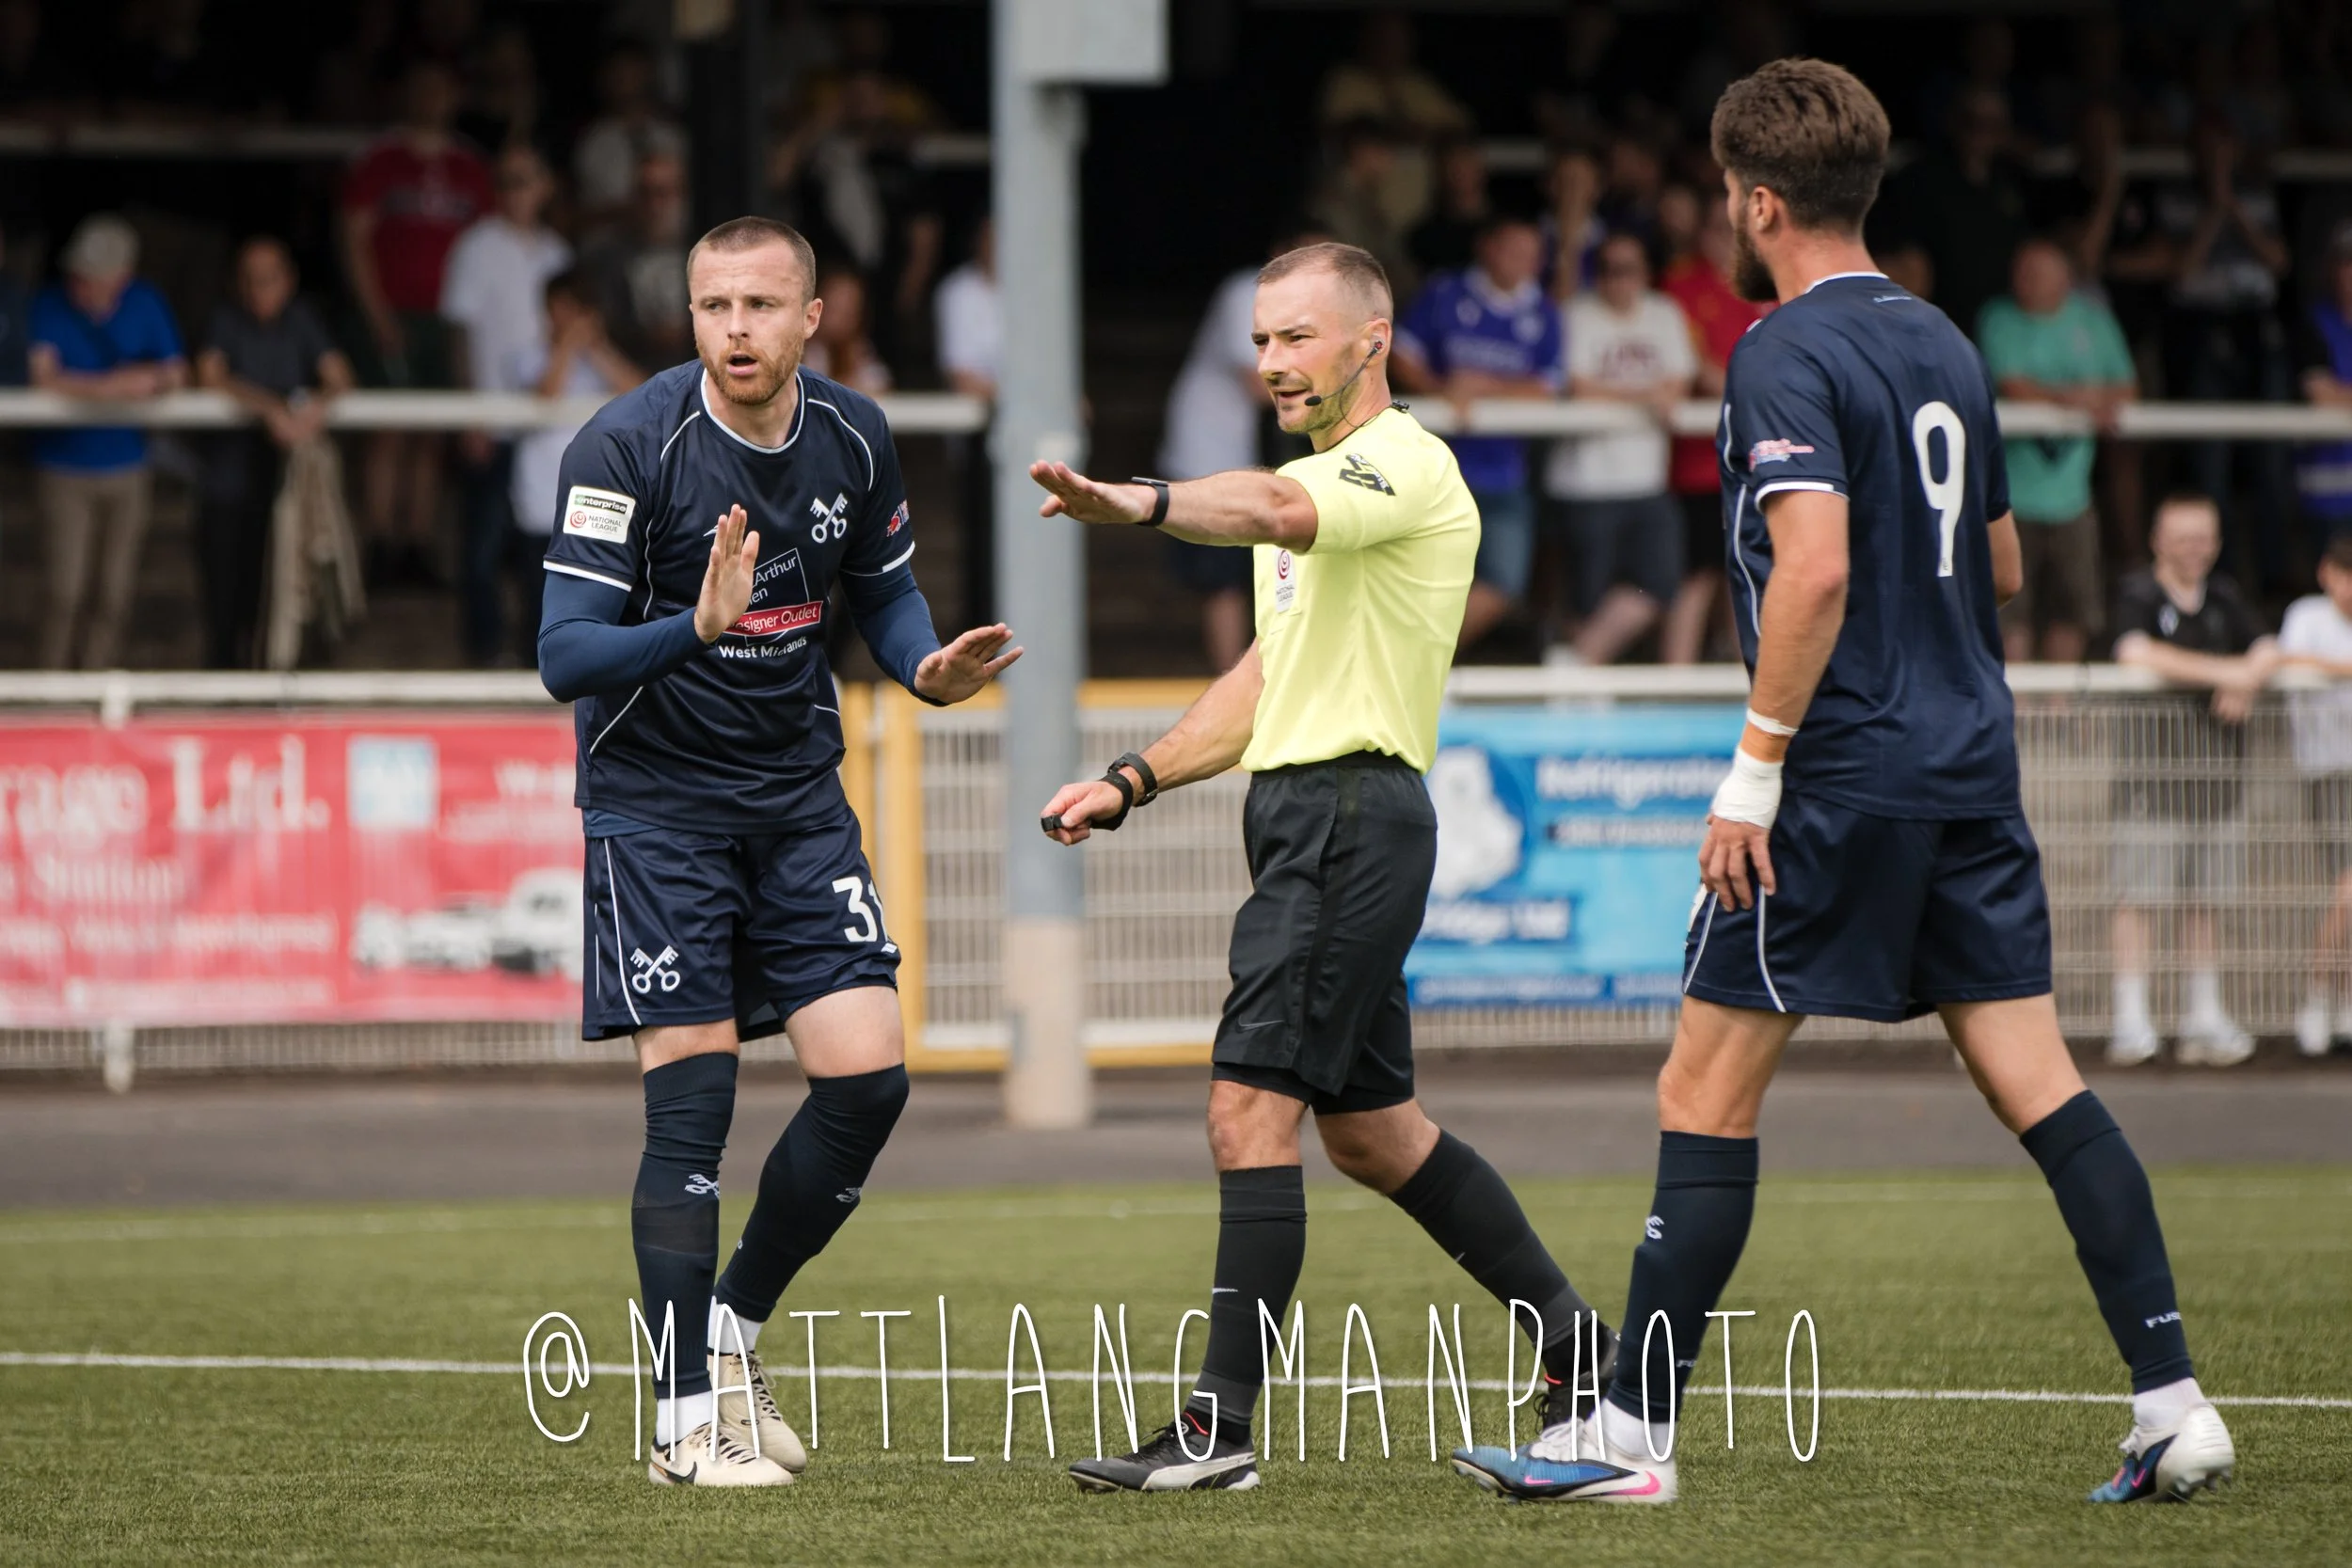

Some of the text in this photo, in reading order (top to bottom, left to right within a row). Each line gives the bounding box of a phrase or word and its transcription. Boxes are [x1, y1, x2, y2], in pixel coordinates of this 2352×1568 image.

[1913, 401, 1966, 578] 9
[576, 497, 627, 513] enterprise
[588, 515, 622, 527] NATIONAL
[592, 523, 618, 532] LEAGUE
[753, 556, 797, 588] Arthur
[732, 605, 817, 633] esigner Outlet
[719, 646, 757, 658] West
